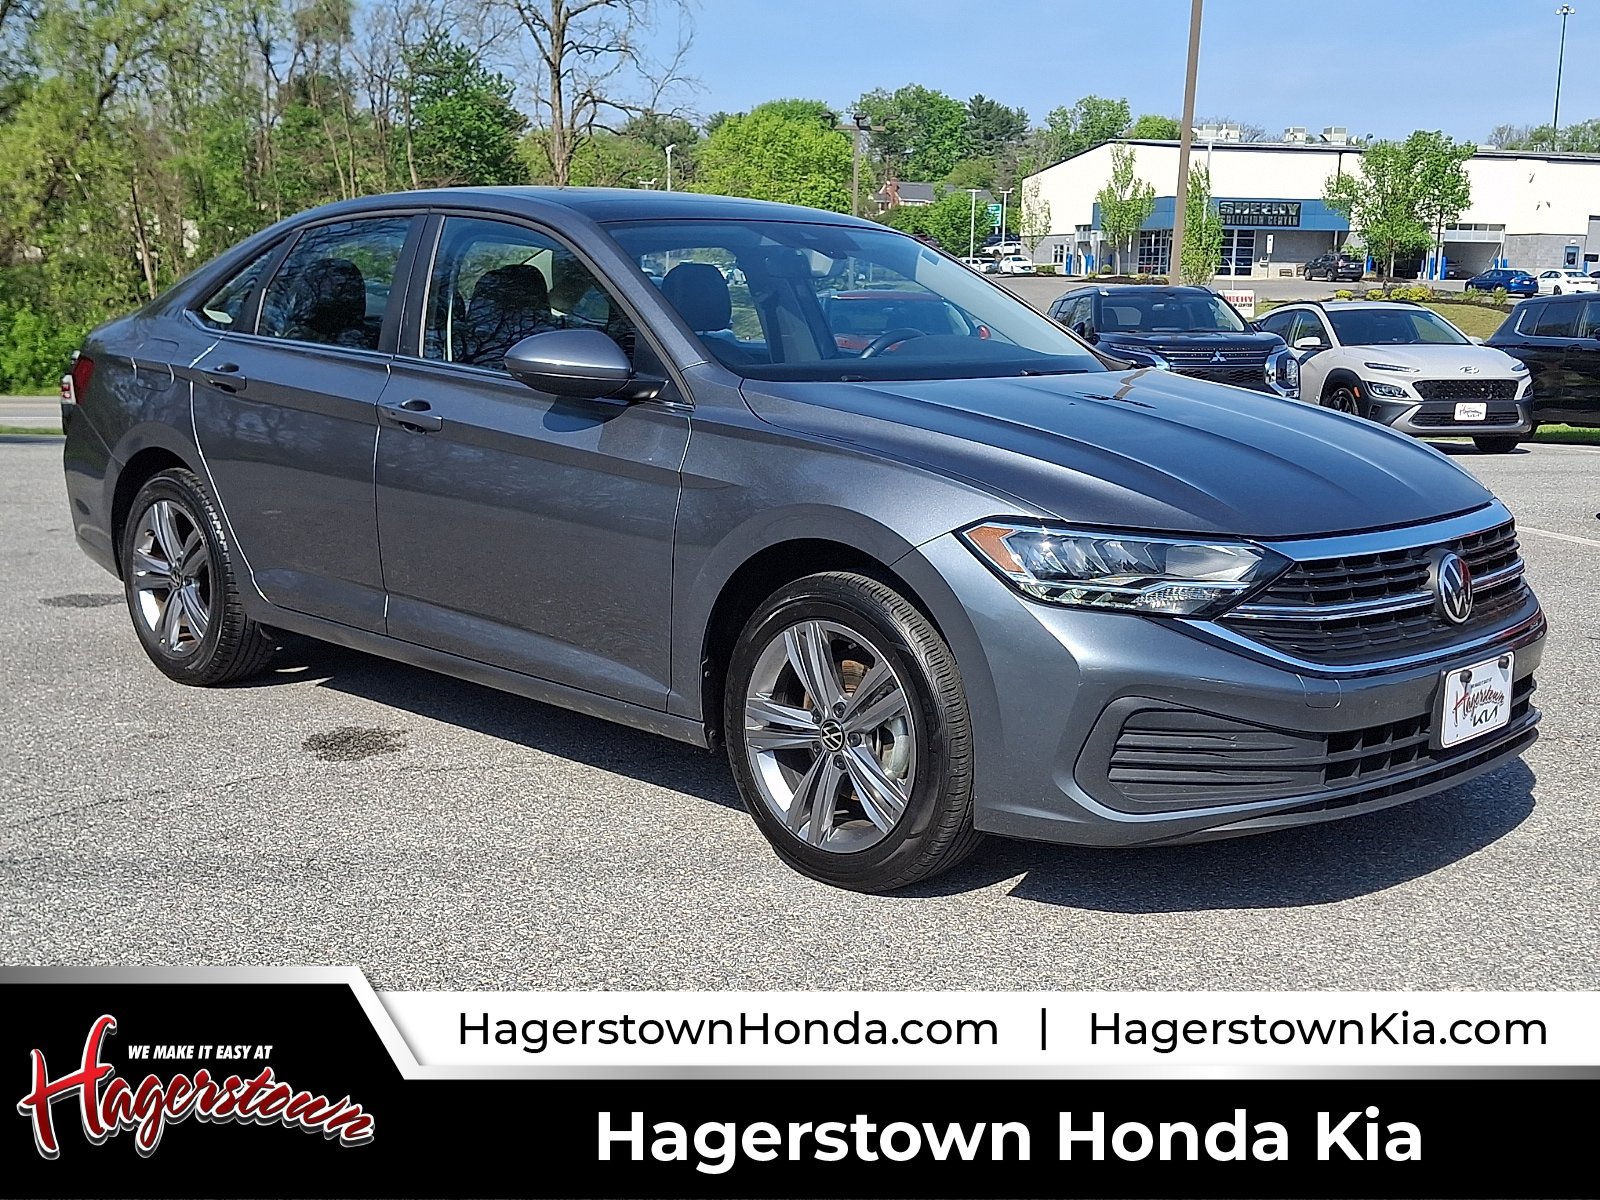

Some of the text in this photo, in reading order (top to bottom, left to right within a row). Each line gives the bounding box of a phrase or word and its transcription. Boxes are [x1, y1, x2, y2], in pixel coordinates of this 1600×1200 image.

[1220, 201, 1300, 216] SHEEHY
[1220, 214, 1298, 226] COLLISION CENTER
